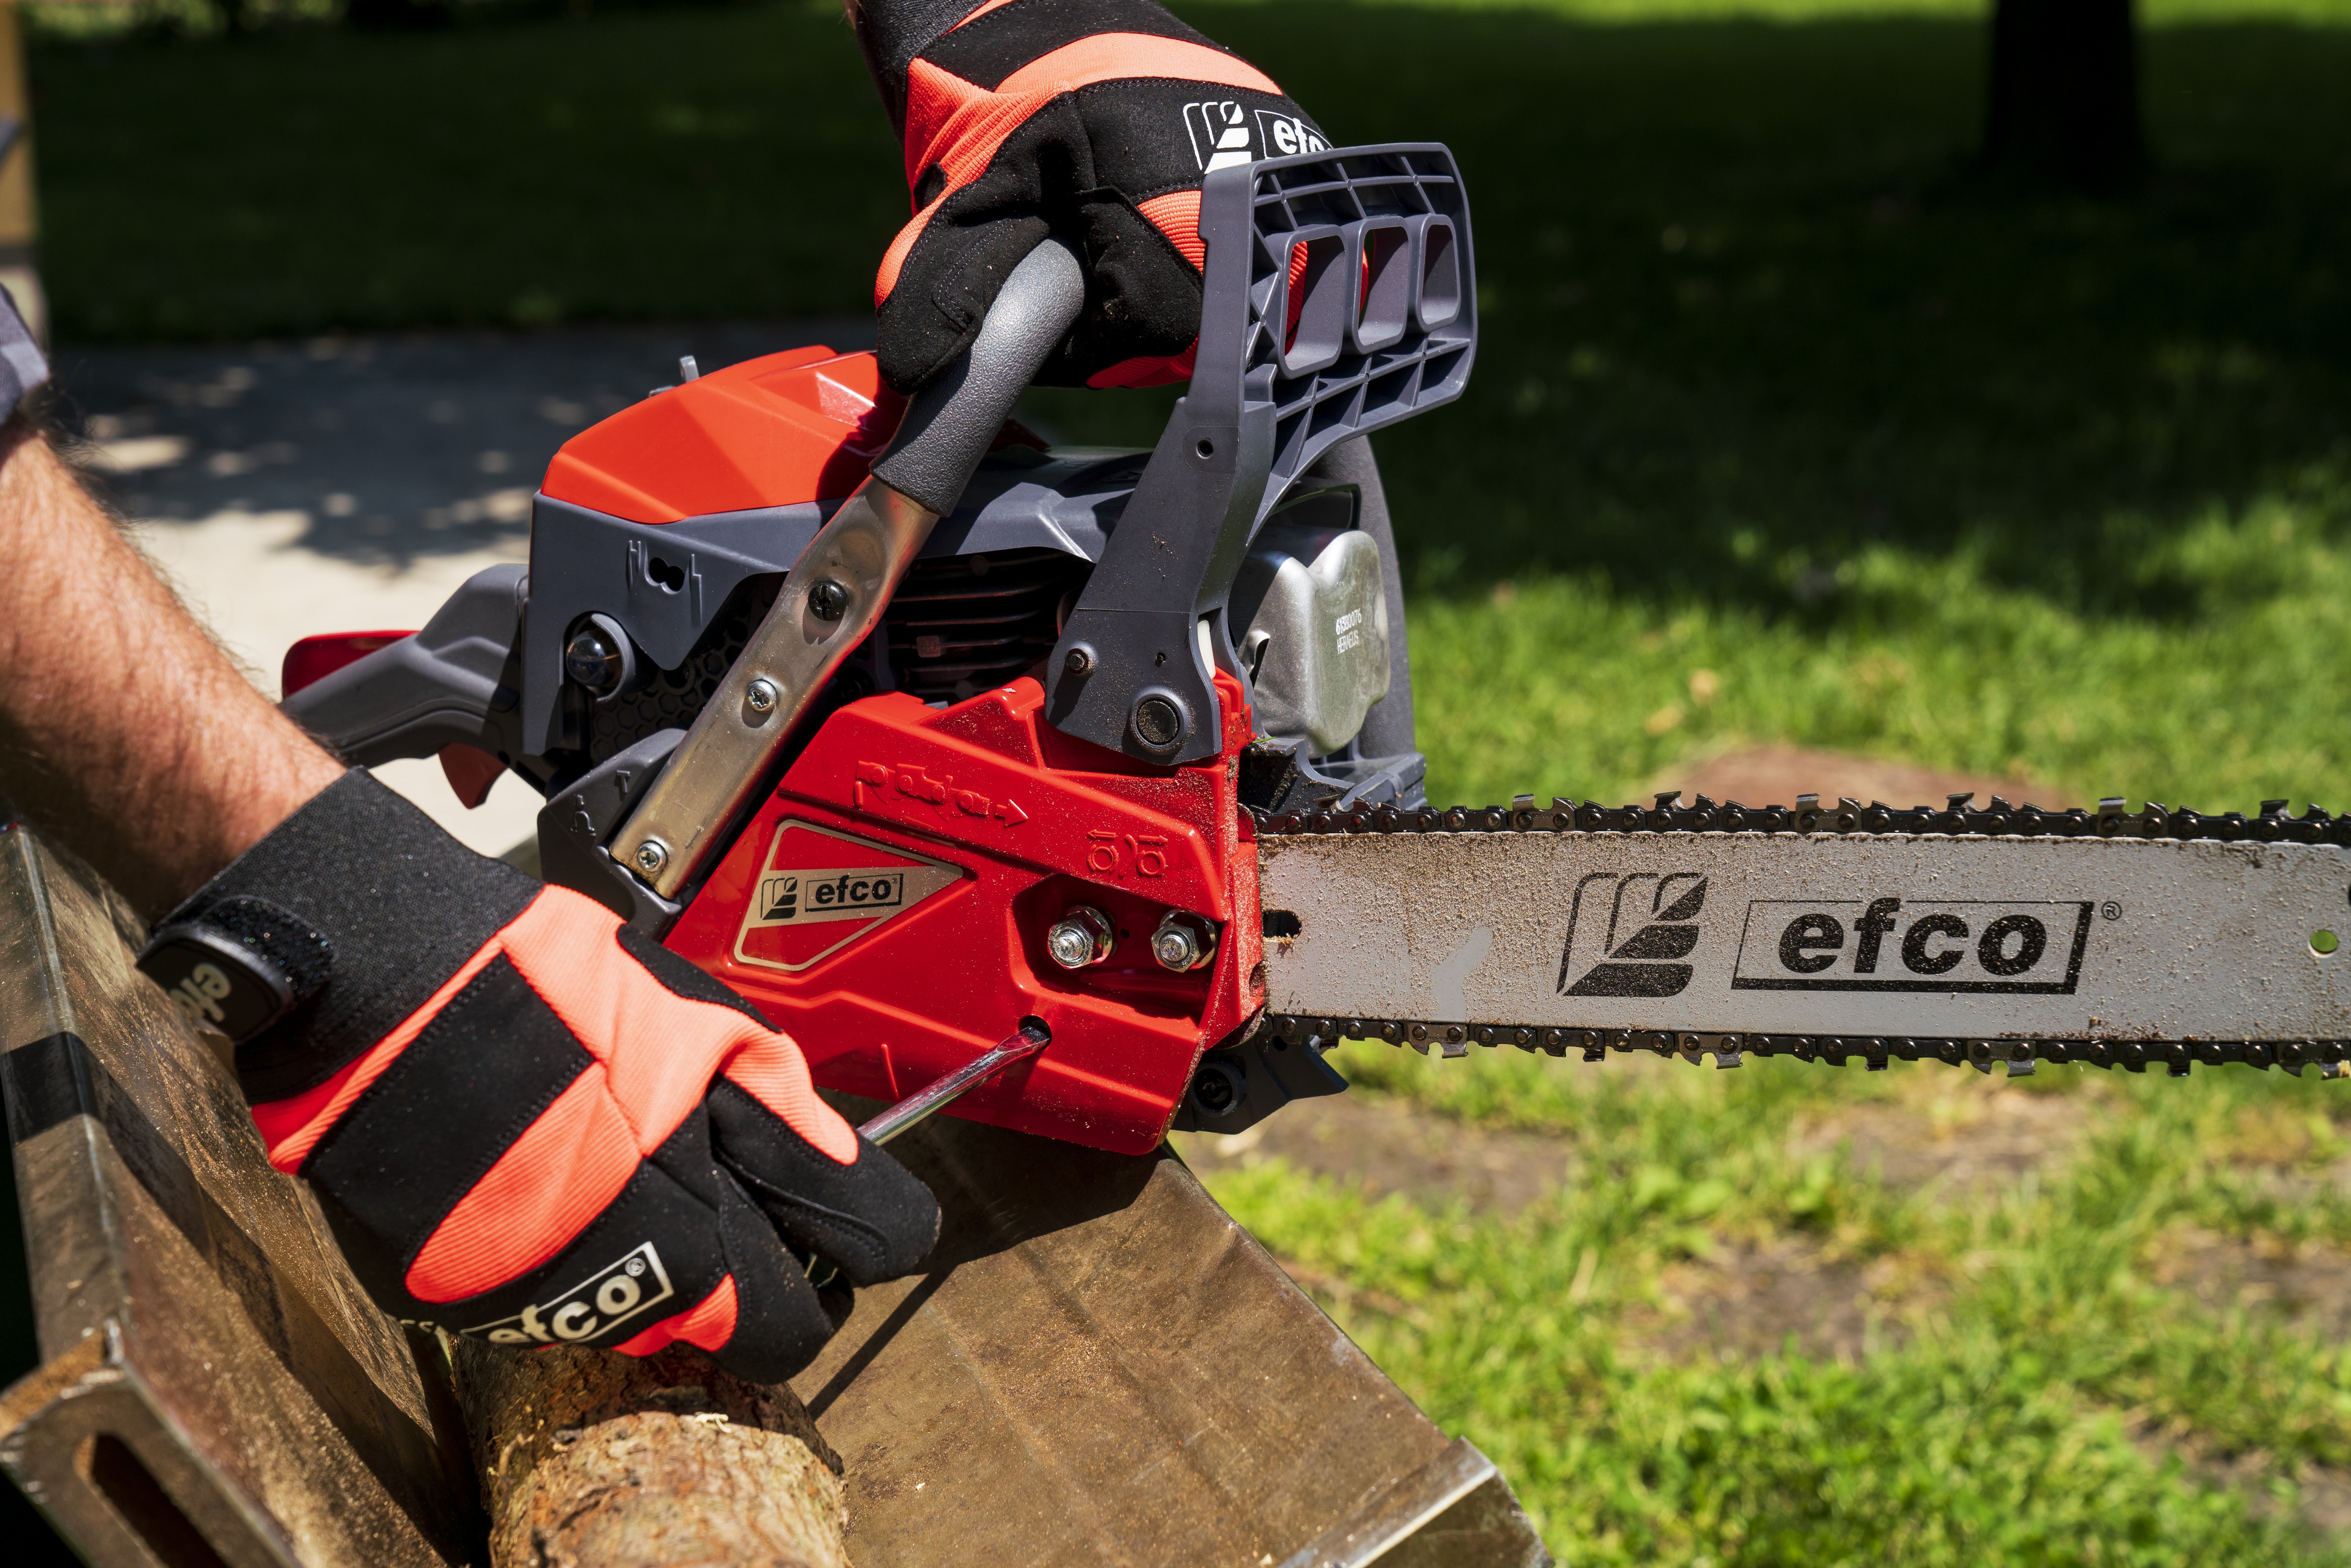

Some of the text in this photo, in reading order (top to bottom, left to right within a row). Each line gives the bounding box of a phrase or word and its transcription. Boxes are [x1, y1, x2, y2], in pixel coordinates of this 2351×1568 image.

[1337, 629, 1359, 654] HERAEUS
[815, 875, 892, 905] efco
[1778, 897, 2047, 976] efco
